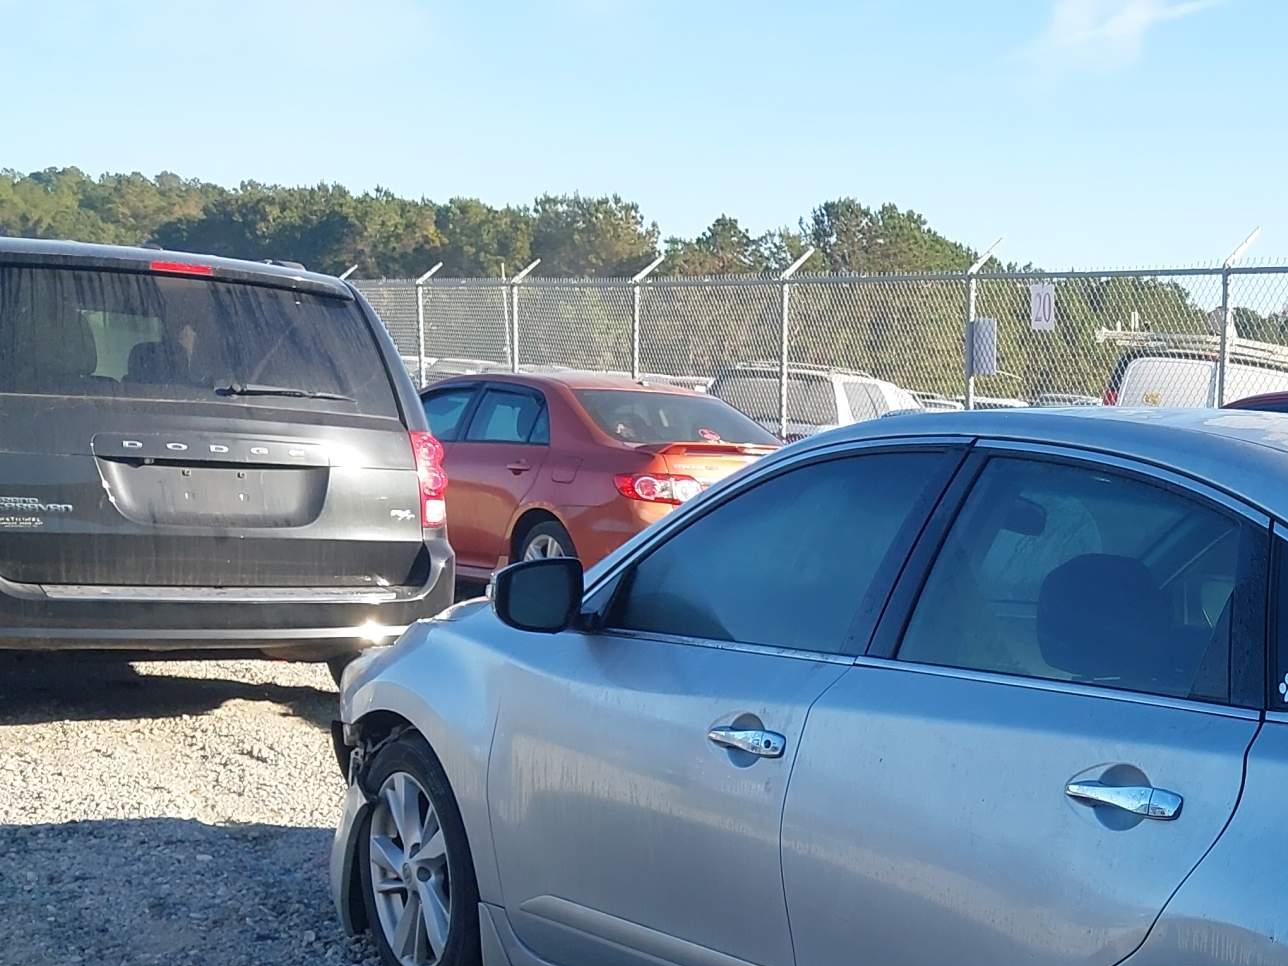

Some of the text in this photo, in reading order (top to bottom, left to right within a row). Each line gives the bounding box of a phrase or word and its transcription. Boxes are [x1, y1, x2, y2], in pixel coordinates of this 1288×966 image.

[1033, 292, 1052, 323] 20
[122, 440, 306, 458] DODGE
[0, 496, 39, 504] RAND
